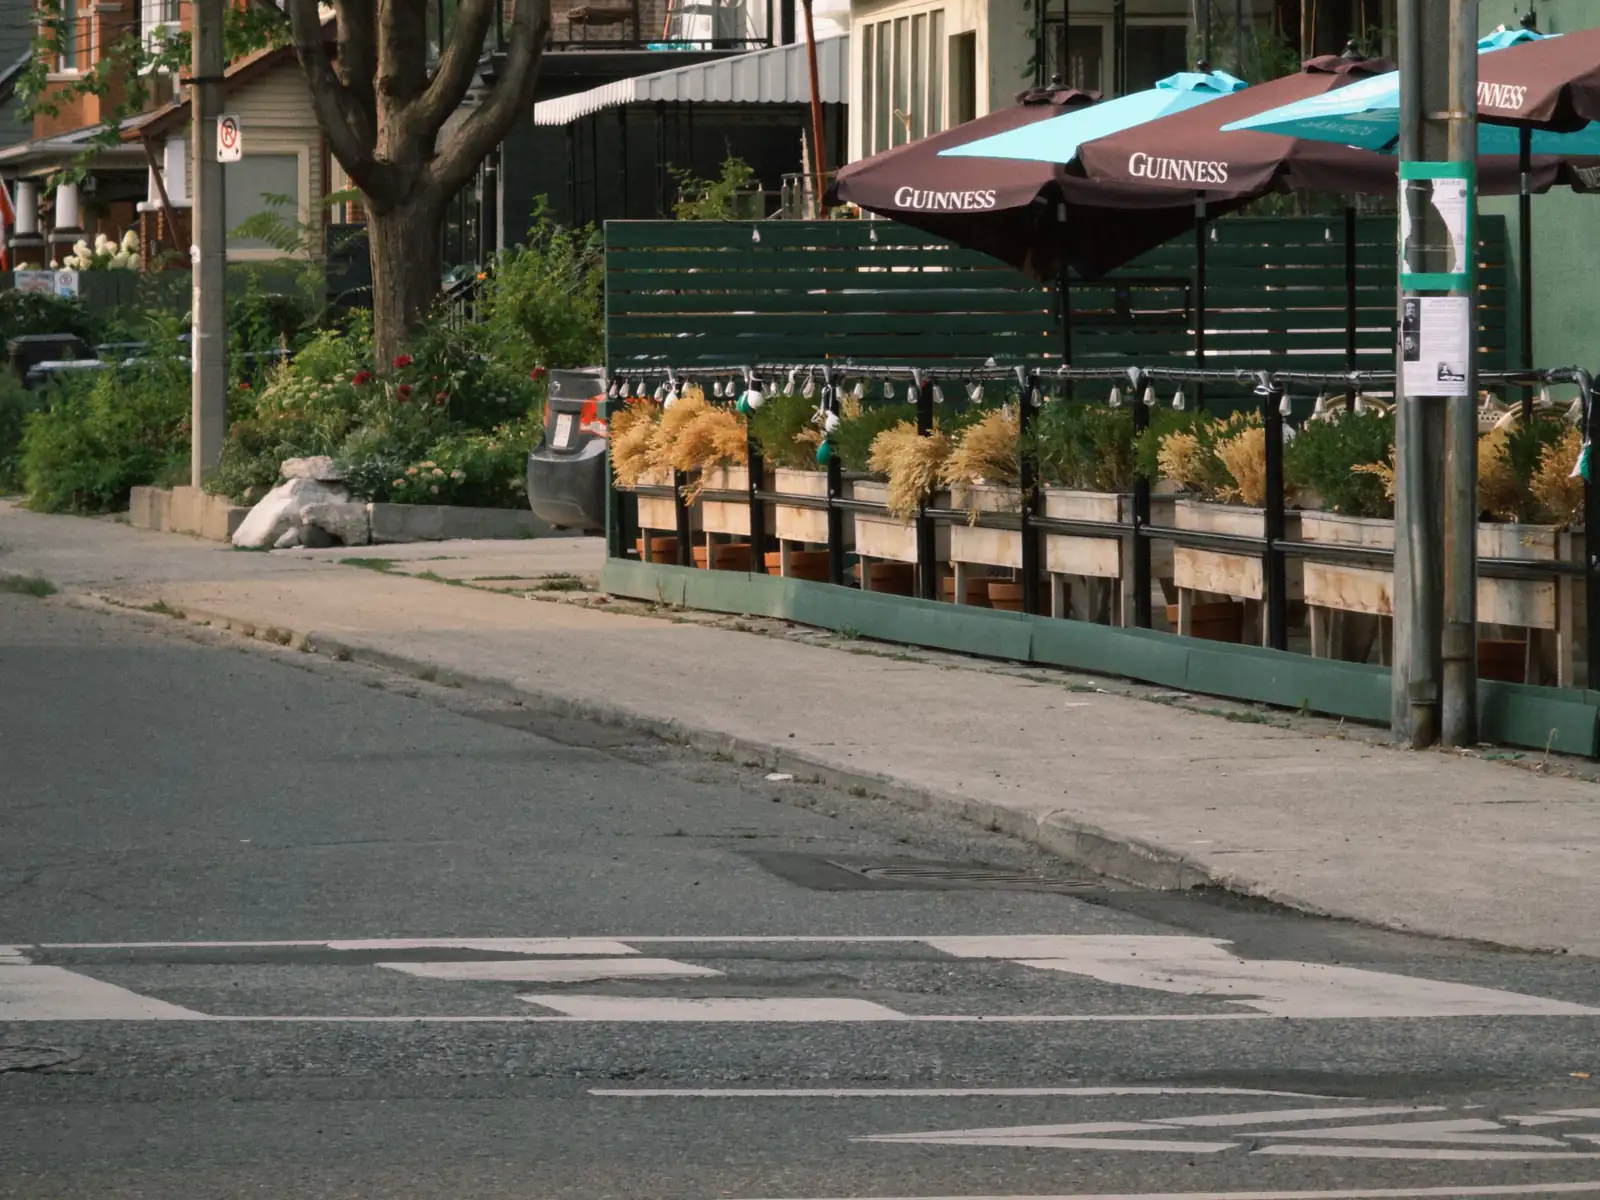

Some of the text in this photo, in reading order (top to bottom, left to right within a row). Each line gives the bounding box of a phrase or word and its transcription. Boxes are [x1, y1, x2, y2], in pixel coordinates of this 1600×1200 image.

[1477, 81, 1527, 110] INNESS
[1128, 152, 1228, 184] GUINNESS
[894, 186, 996, 209] GUINNESS
